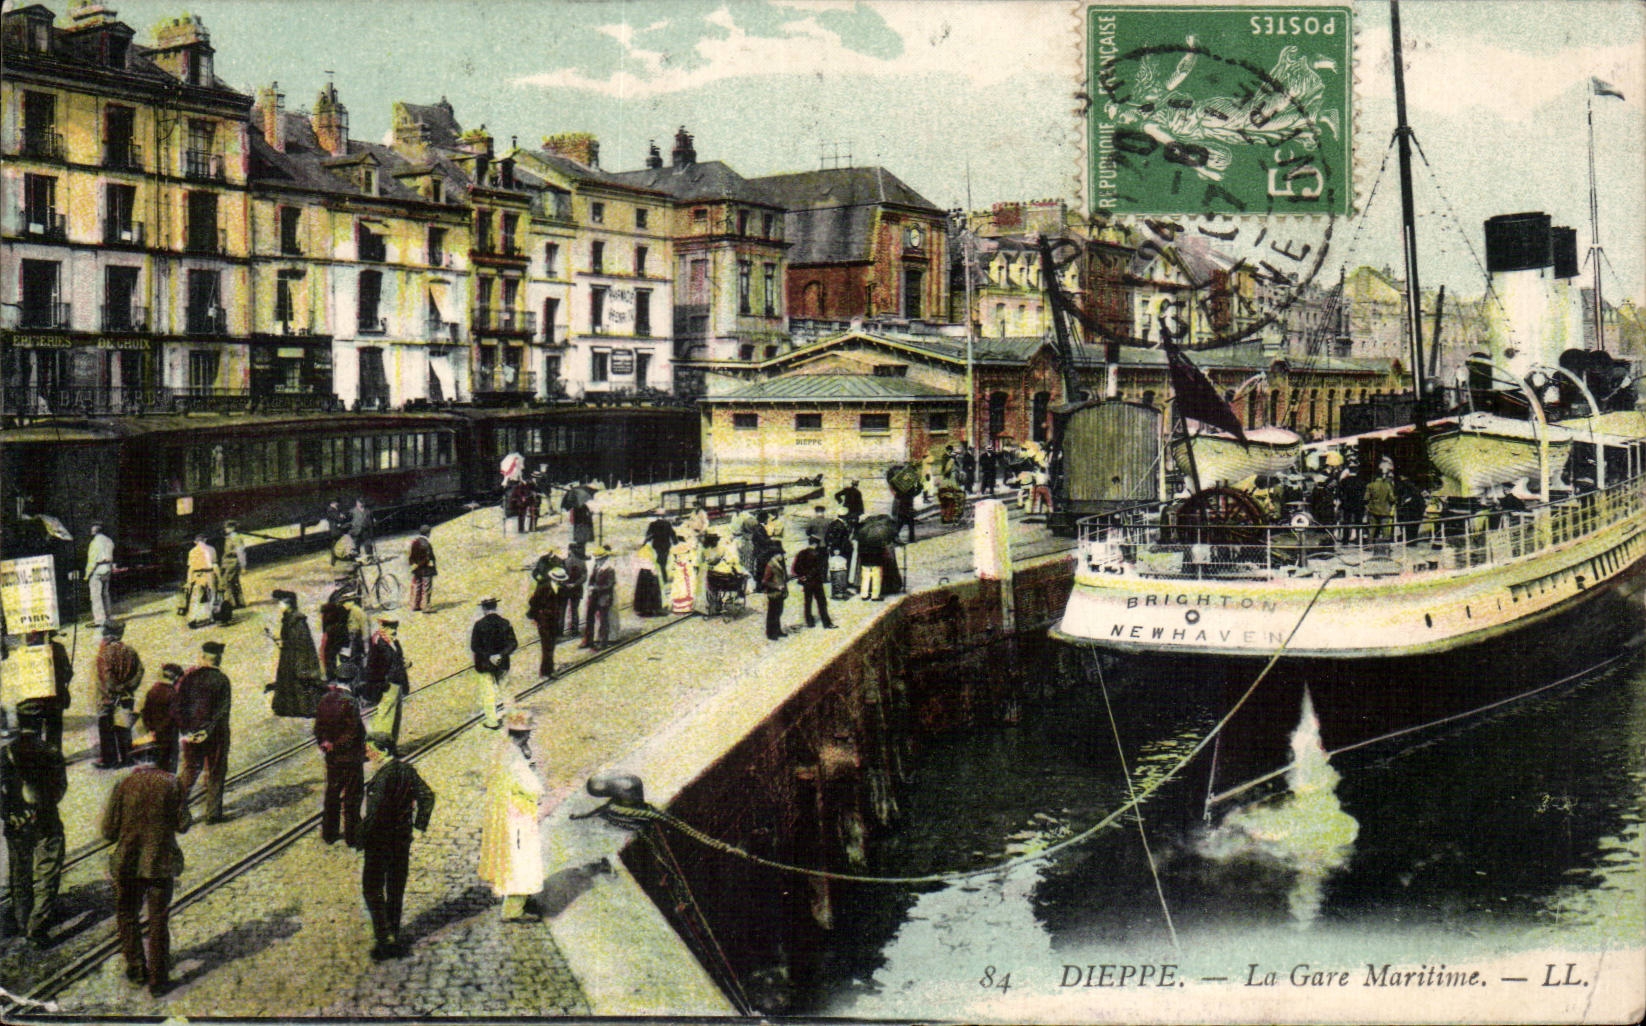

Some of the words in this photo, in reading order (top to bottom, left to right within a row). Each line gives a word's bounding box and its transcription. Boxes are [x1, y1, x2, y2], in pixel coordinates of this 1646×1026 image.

[1250, 16, 1335, 35] POSTES
[795, 438, 822, 447] DIEPPE
[1127, 593, 1276, 613] BRIGHTON
[1110, 624, 1284, 643] NEWHAVEN
